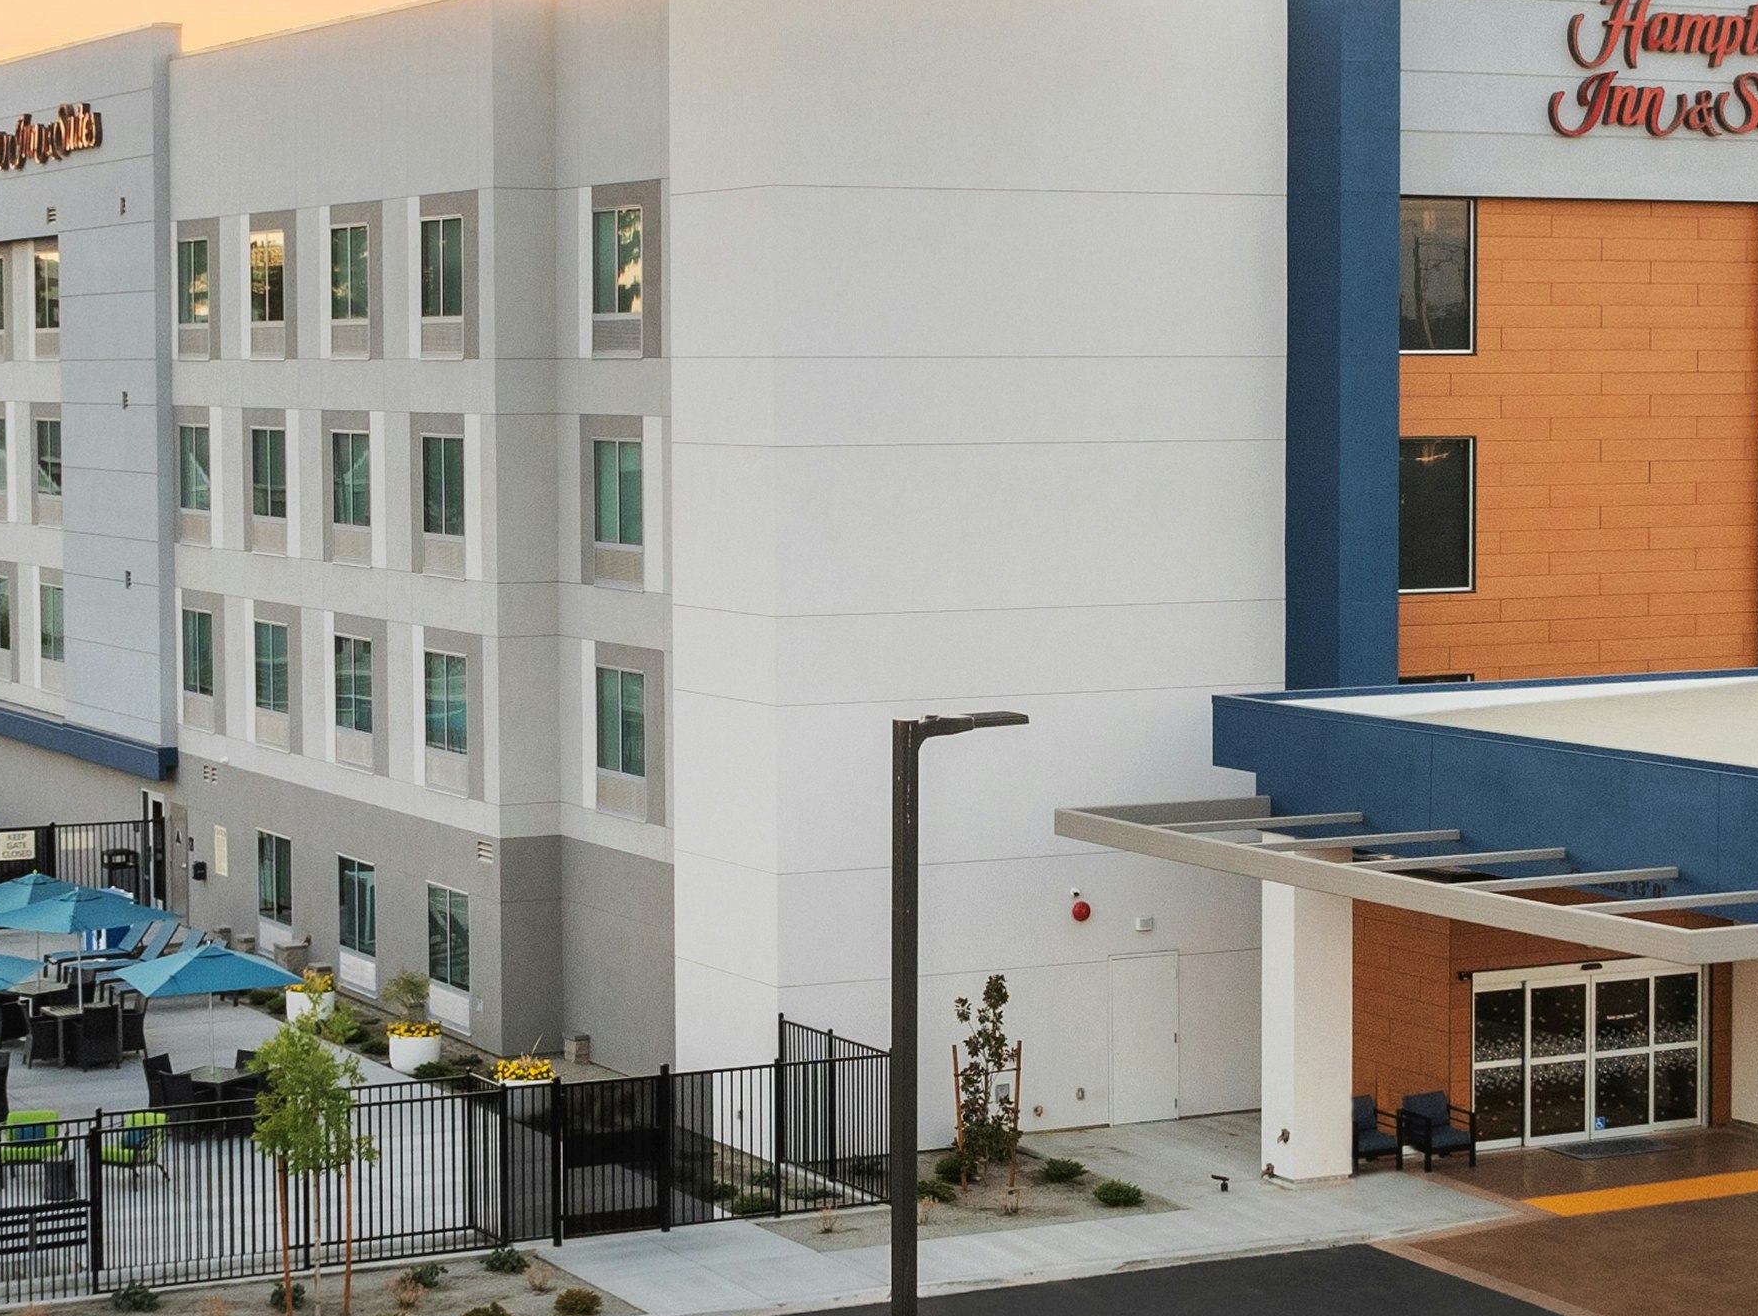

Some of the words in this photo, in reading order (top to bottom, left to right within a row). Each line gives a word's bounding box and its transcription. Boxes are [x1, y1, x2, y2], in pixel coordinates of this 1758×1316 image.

[1547, 70, 1687, 137] Inn
[1683, 90, 1722, 137] &
[6, 841, 26, 849] GATE
[2, 850, 32, 858] CLOSED
